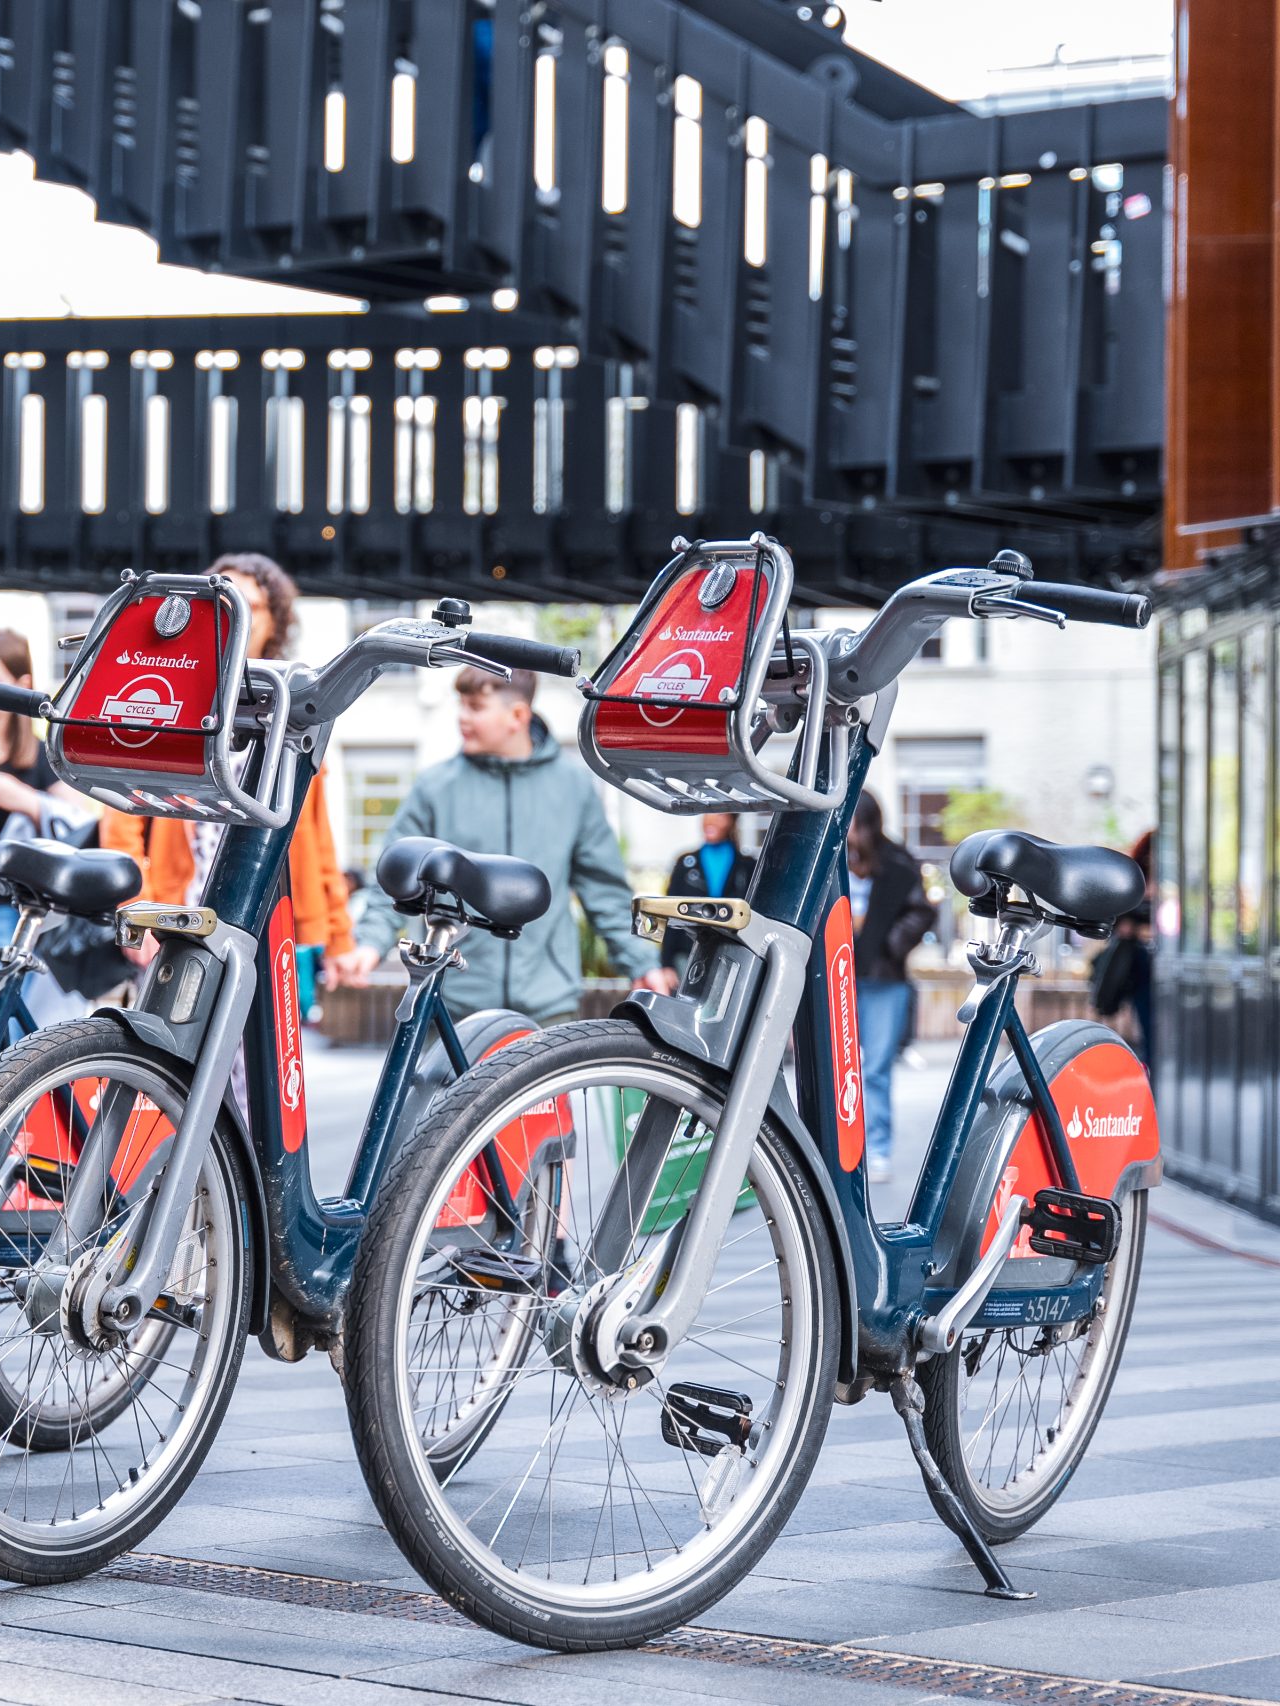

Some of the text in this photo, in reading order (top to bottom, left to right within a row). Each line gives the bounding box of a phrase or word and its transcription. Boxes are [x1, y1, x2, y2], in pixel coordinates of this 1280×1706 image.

[672, 625, 733, 642] Santander
[131, 651, 199, 669] Santander
[656, 681, 686, 691] CYCLES
[125, 705, 156, 715] CYCLES
[282, 968, 295, 1054] Santander
[839, 976, 852, 1066] Santander
[1083, 1103, 1143, 1138] Santander
[794, 1173, 813, 1208] PLUS
